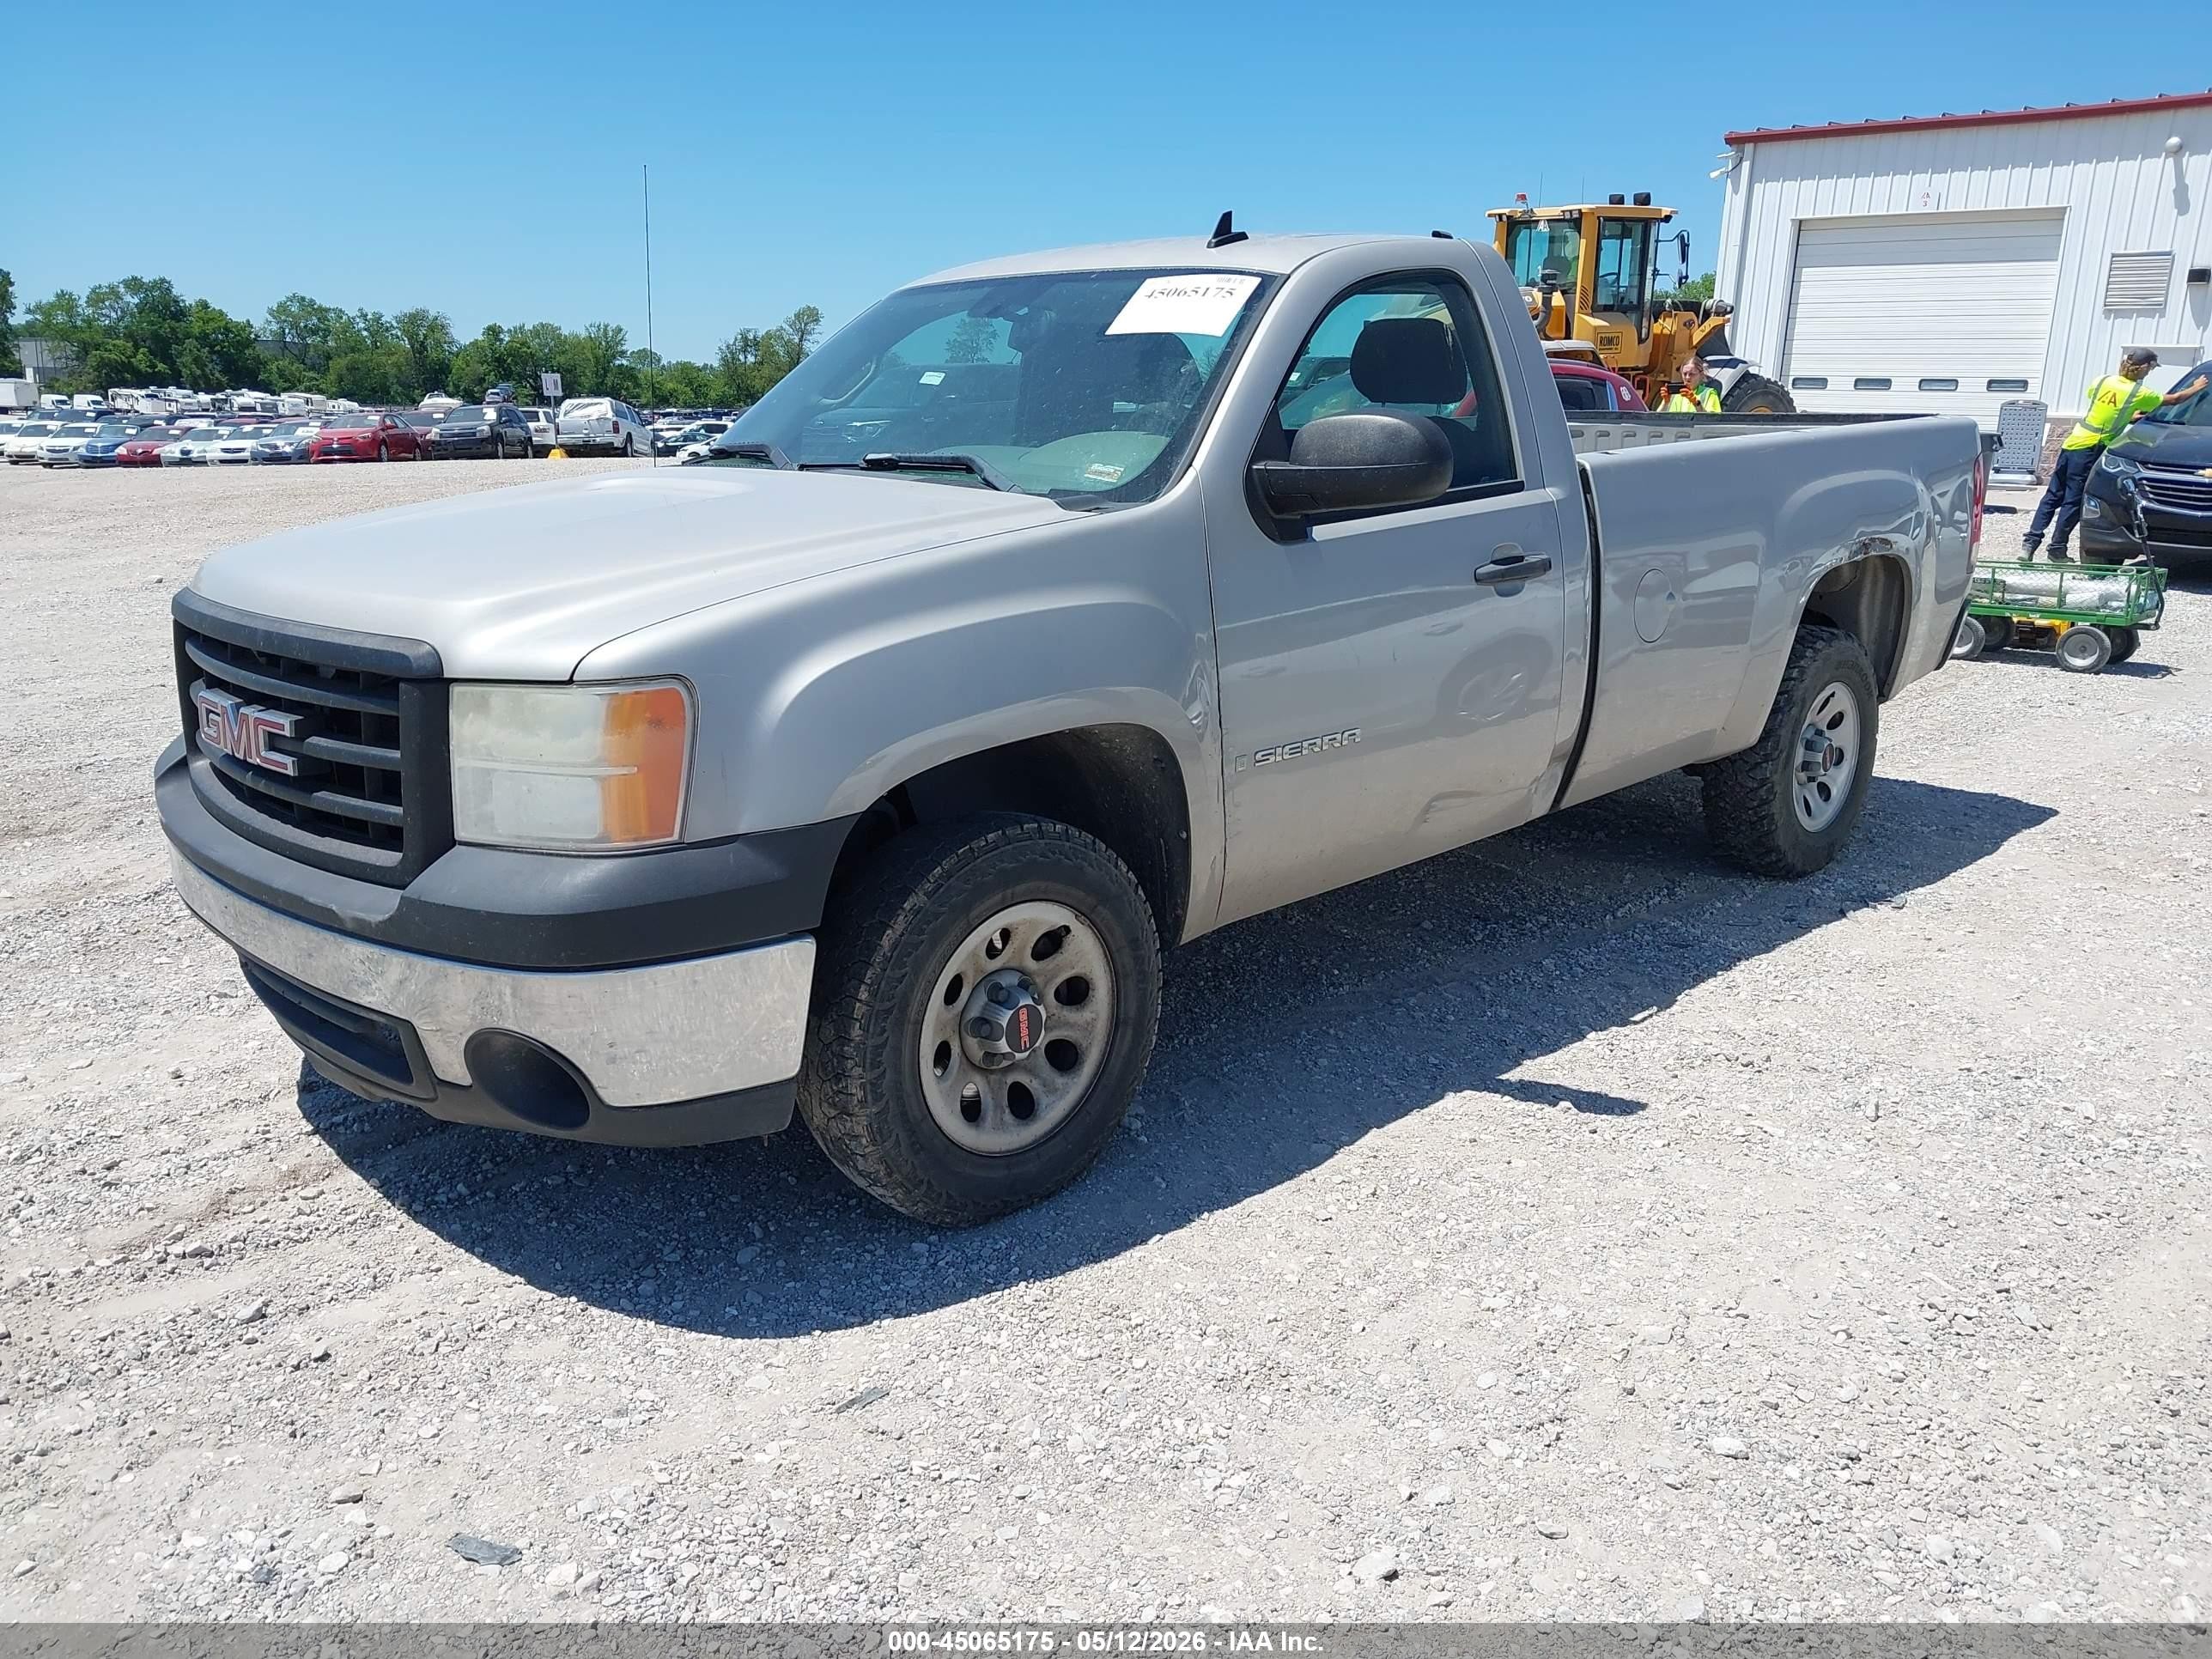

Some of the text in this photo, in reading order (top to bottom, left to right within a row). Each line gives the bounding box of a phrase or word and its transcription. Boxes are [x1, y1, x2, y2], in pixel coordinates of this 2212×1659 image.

[1144, 286, 1239, 300] 45065175
[1599, 335, 1620, 347] ROMCO
[544, 378, 559, 391] L M
[198, 689, 301, 777] GMC
[1254, 727, 1361, 767] SIERRA
[1018, 1007, 1030, 1051] GMC
